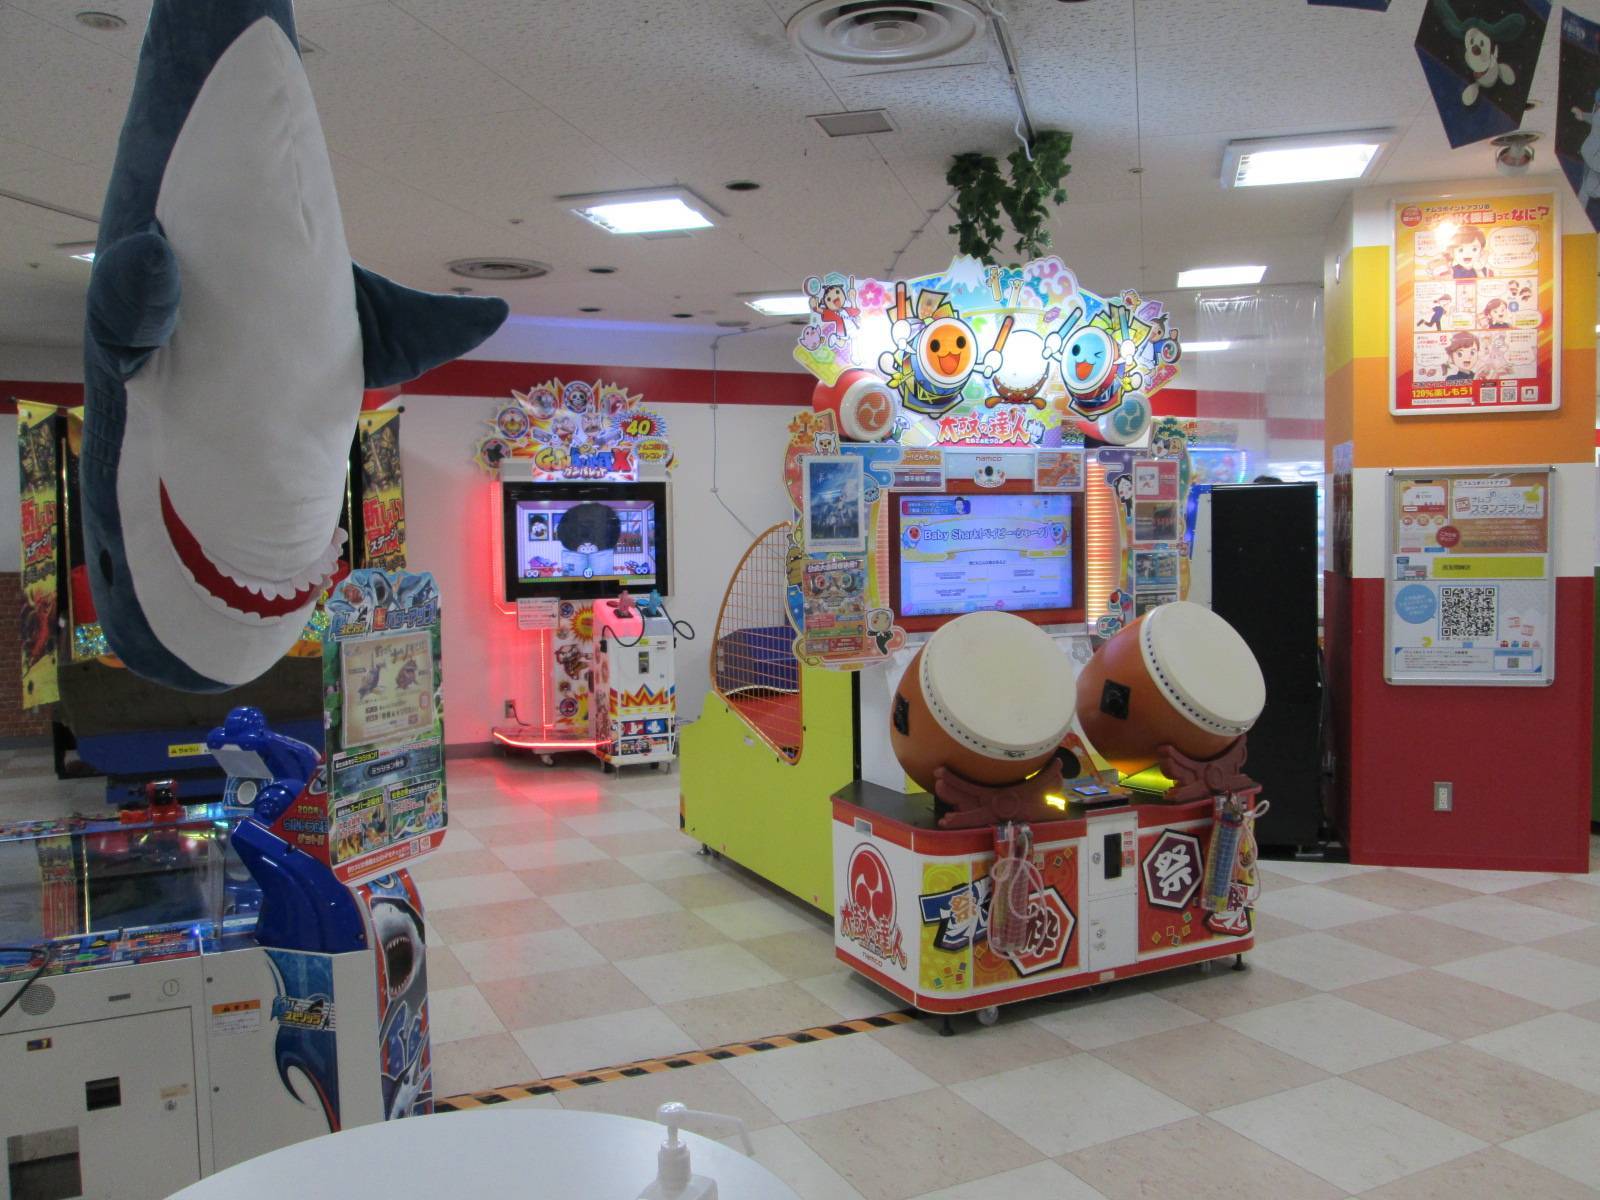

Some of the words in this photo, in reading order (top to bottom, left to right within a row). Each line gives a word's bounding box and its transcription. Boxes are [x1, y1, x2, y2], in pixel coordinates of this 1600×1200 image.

[626, 420, 651, 436] 40
[937, 411, 1031, 443] 太鼓の達人
[923, 529, 949, 542] Baby
